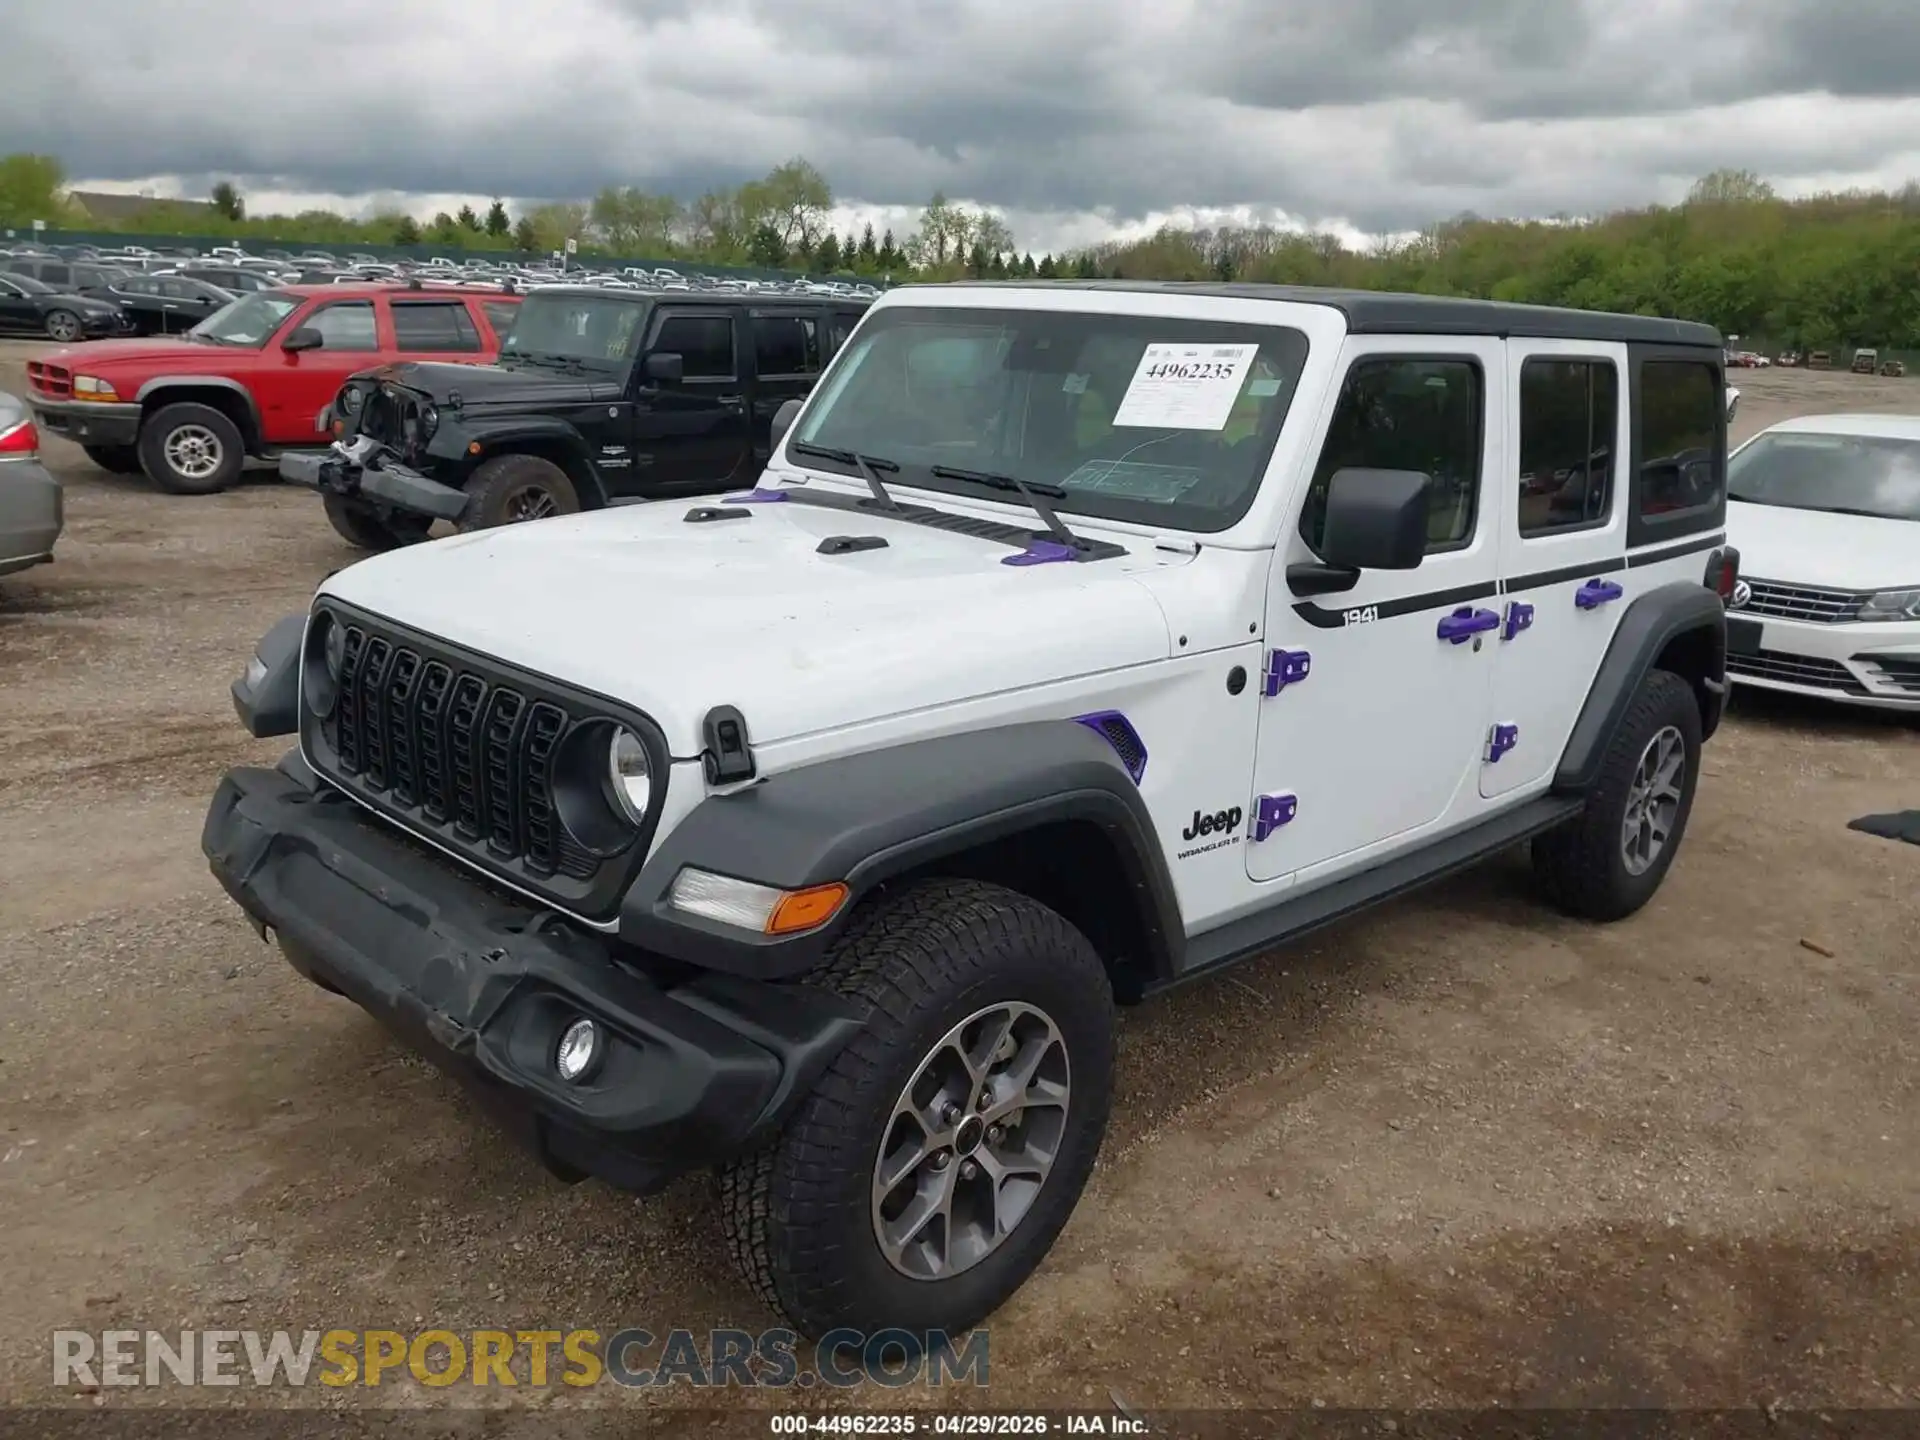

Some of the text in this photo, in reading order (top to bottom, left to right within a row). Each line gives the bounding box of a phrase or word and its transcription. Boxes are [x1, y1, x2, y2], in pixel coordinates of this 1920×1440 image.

[1146, 363, 1235, 379] 44962235
[1342, 606, 1378, 627] 1941
[1182, 806, 1242, 841] Jeep
